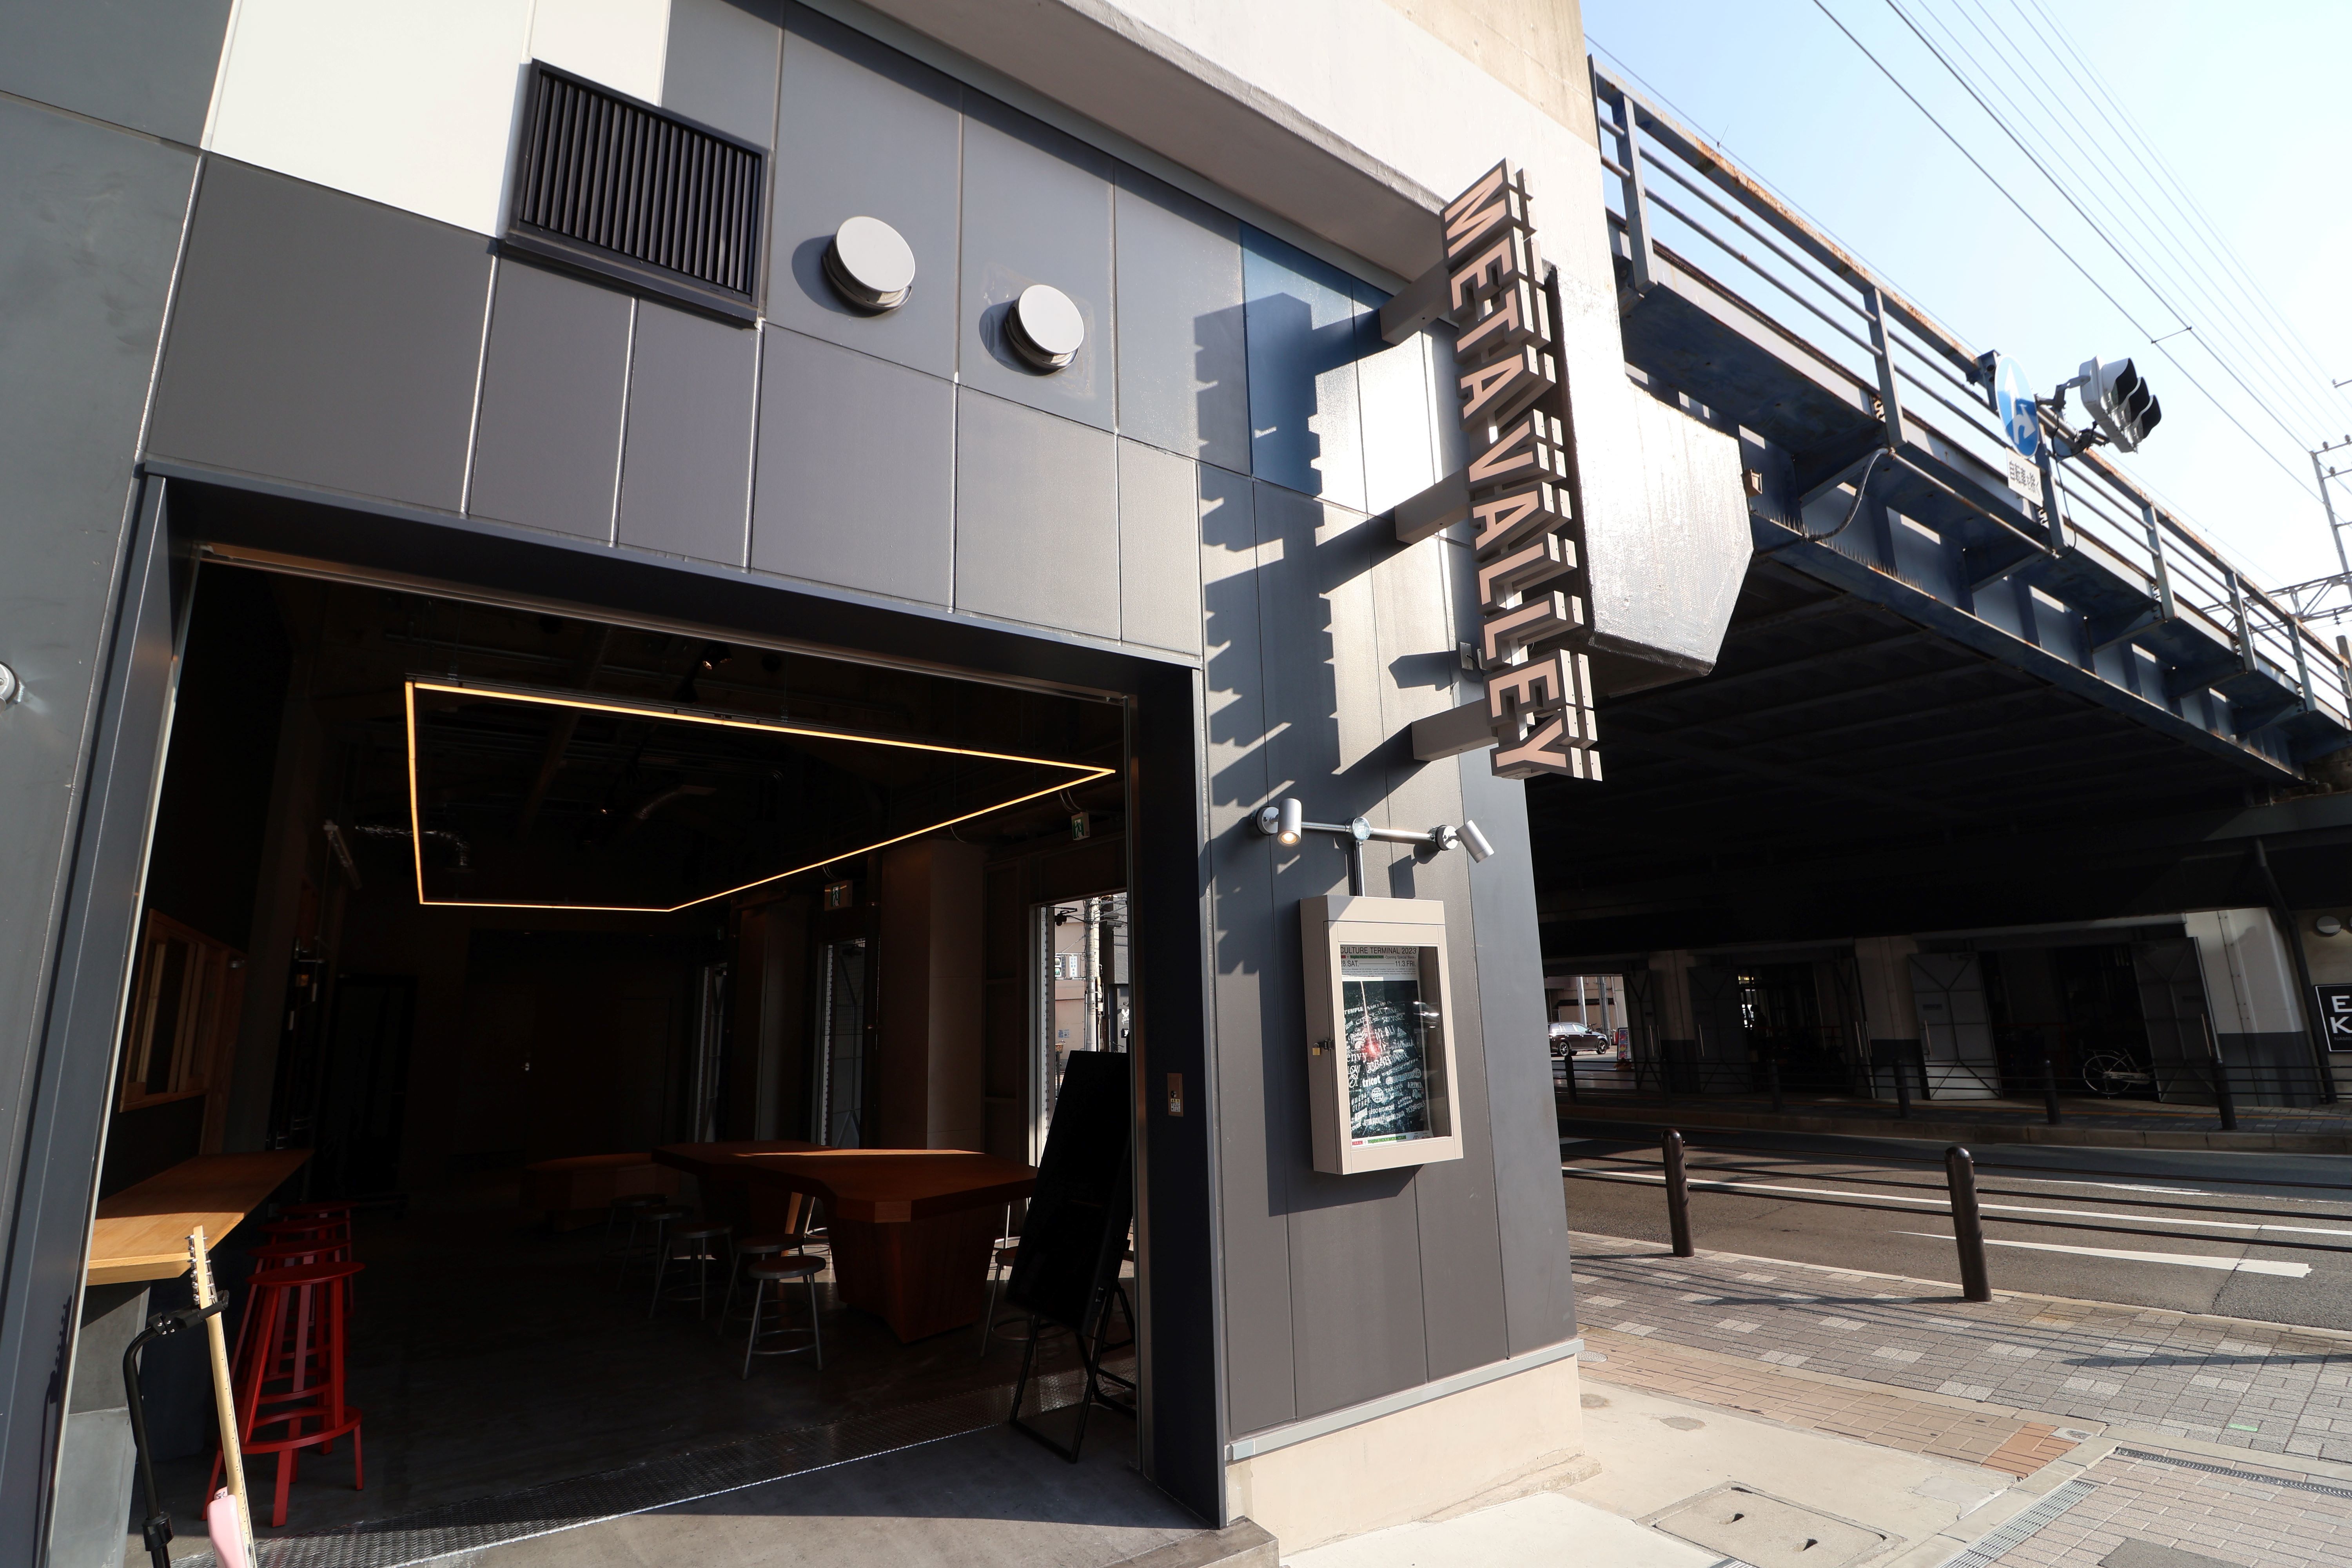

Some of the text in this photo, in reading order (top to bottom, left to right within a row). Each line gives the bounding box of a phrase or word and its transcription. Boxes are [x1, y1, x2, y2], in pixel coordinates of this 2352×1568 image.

[1441, 158, 1573, 776] METAVALLEY
[1347, 1053, 1367, 1063] envy
[1362, 1075, 1381, 1087] tricot
